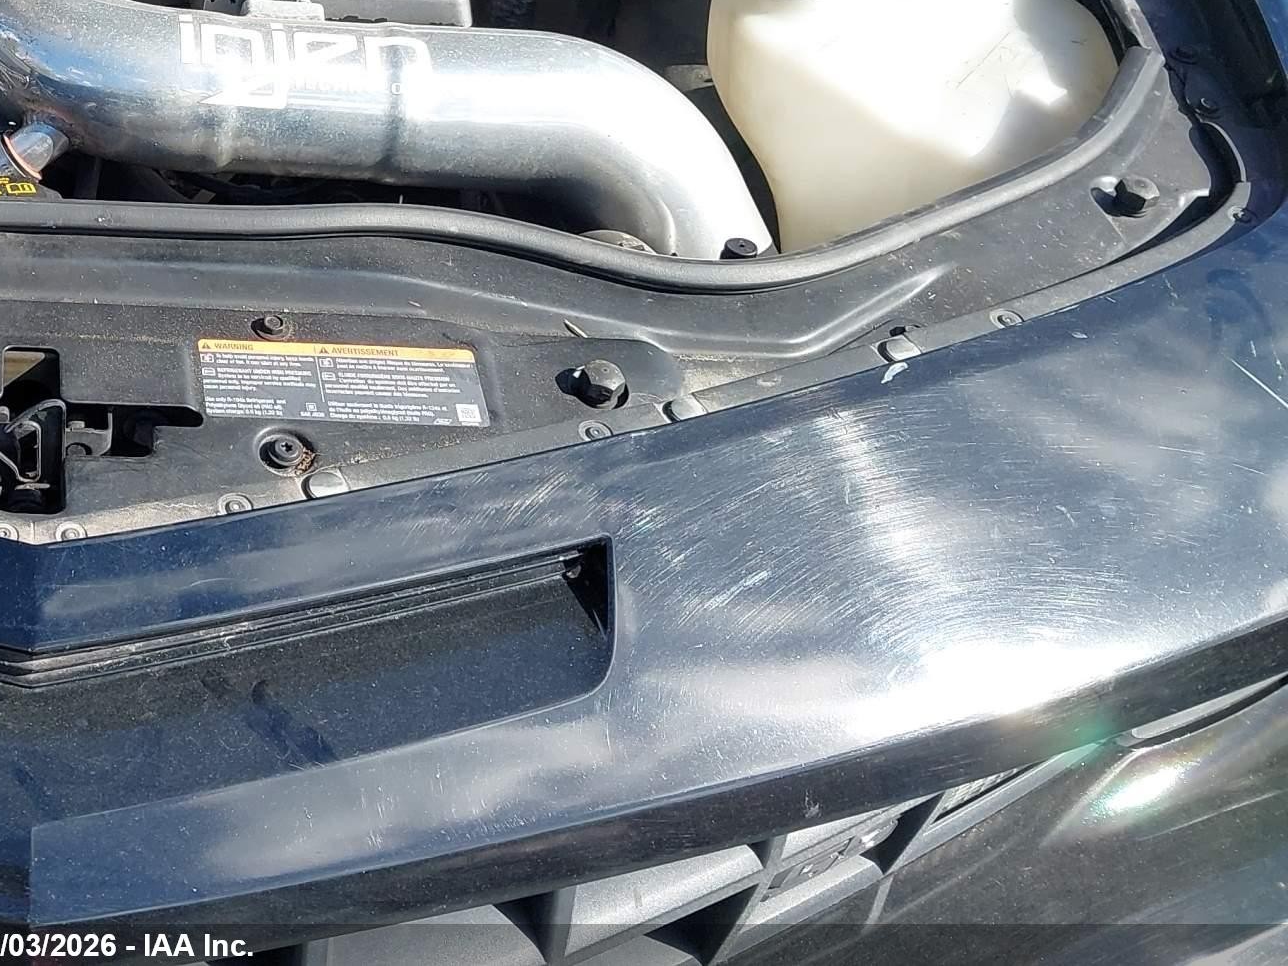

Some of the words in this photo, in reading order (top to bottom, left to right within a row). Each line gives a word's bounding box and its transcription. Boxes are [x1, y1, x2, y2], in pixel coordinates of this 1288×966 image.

[178, 13, 432, 110] injen
[214, 342, 254, 351] WARNING
[331, 348, 399, 357] AVERTISSEMENT
